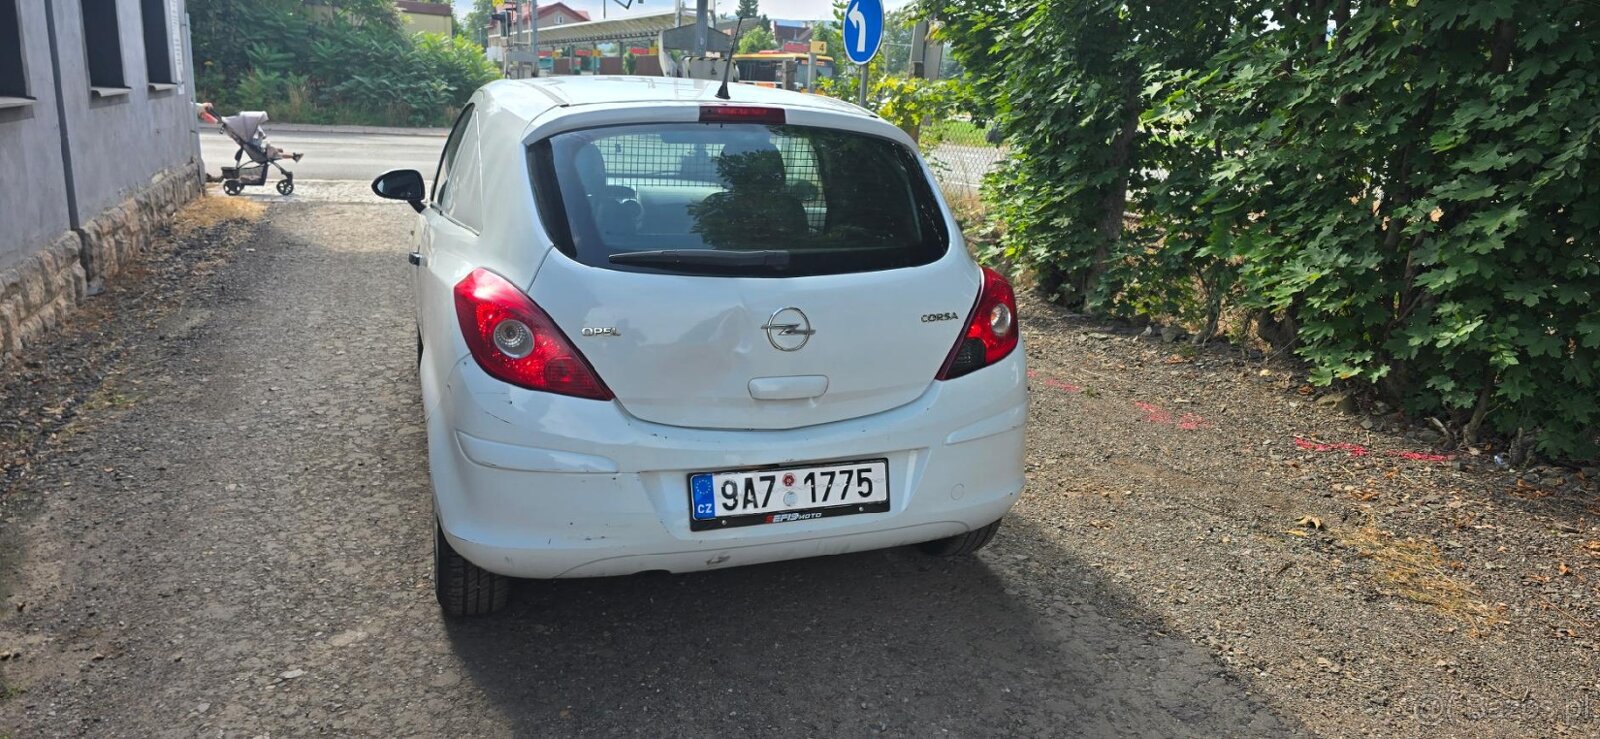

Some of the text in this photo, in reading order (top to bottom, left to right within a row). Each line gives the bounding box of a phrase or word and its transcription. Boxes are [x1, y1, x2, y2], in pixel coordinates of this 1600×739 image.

[920, 311, 959, 323] CORSA
[581, 327, 621, 337] OPEL
[720, 468, 873, 511] 9A7 1775
[697, 503, 713, 514] CZ
